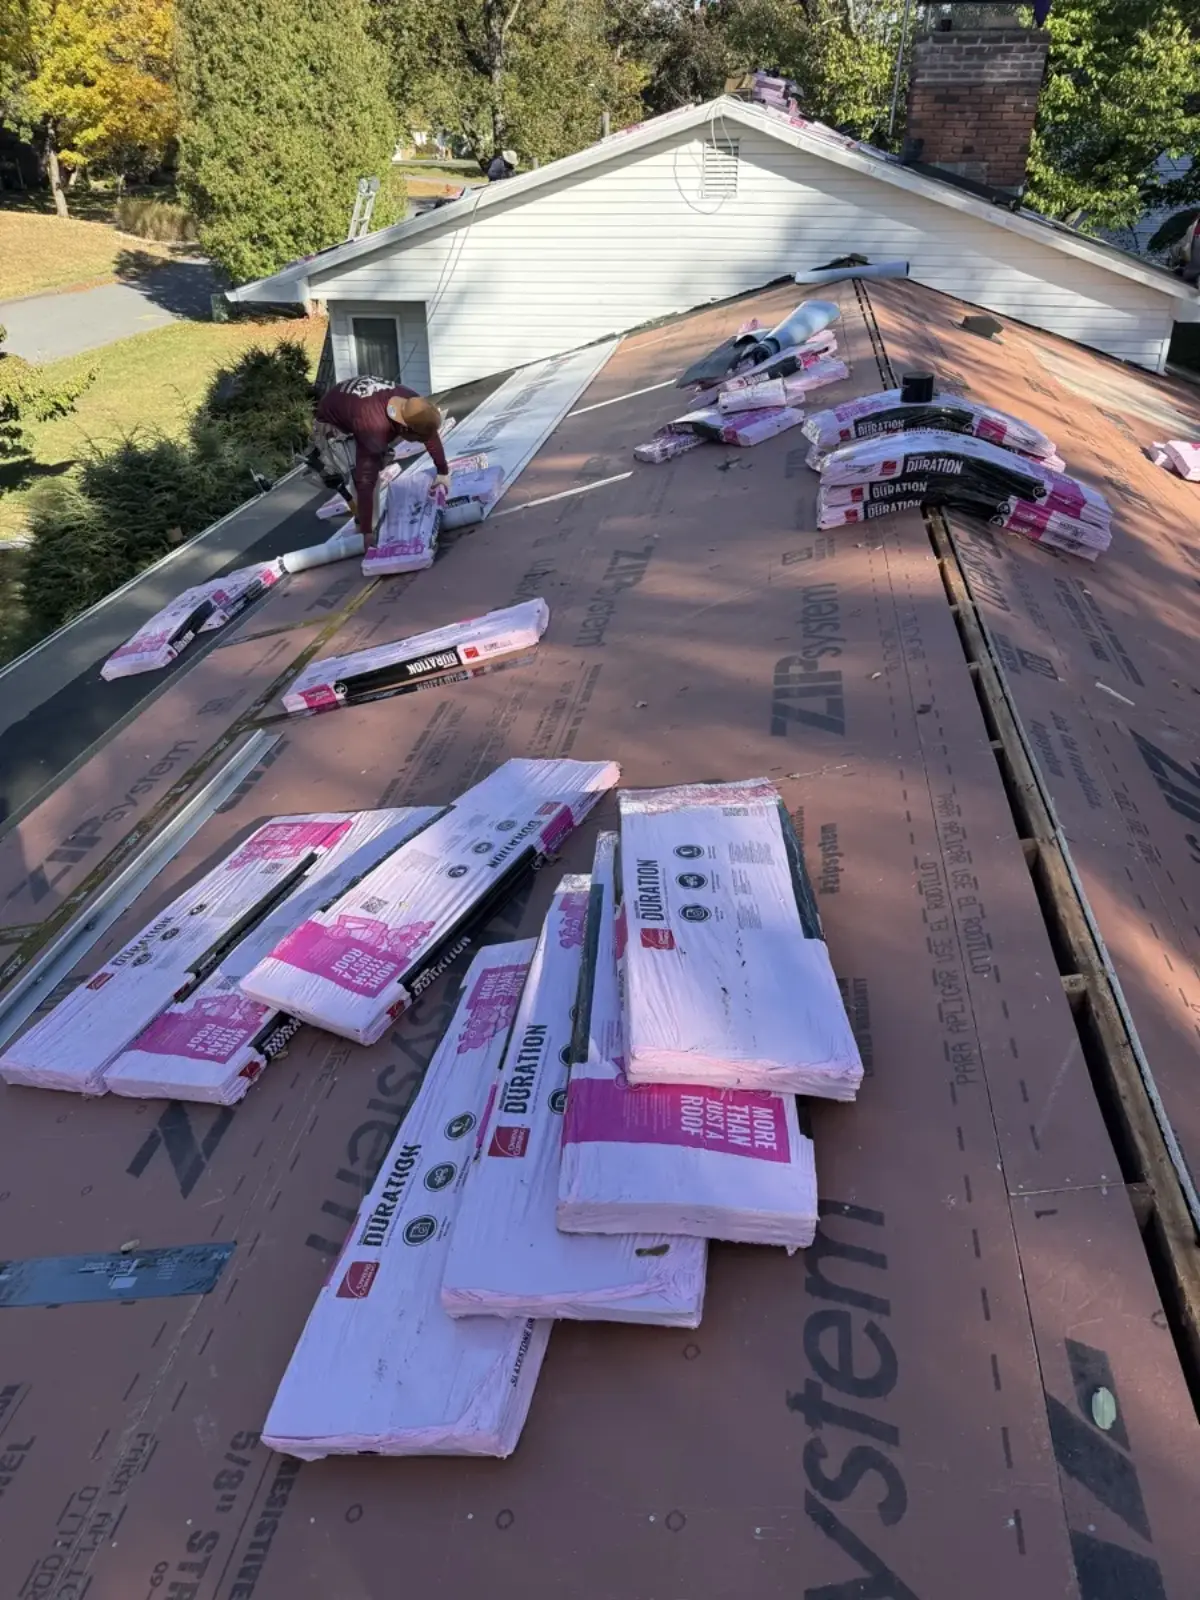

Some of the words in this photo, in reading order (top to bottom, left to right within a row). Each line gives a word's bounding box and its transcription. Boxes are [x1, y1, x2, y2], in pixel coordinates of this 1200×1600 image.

[857, 419, 905, 438] DURATION
[906, 457, 964, 475] DURATION
[872, 482, 928, 500] DURATION
[867, 499, 922, 518] DURATION
[406, 651, 458, 676] DURATION
[770, 582, 847, 737] ZIPsystem
[486, 819, 542, 869] DURATION
[636, 858, 665, 921] DURATION
[919, 861, 946, 911] RODILLO
[951, 868, 974, 891] USE
[957, 895, 978, 912] EL
[930, 915, 950, 933] EL
[112, 914, 174, 967] DURATION
[932, 938, 955, 964] USE
[961, 916, 993, 974] RODILLO
[330, 947, 364, 977] ROOF
[341, 971, 353, 980] A
[349, 953, 373, 973] JUST
[363, 961, 398, 991] MORE
[413, 936, 472, 996] DURATION
[477, 972, 500, 1000] MORE
[937, 969, 971, 1034] APLICAR
[186, 1023, 217, 1049] ROOF
[195, 1045, 205, 1053] A
[203, 1026, 226, 1045] JUST
[204, 1027, 235, 1056] THAN
[217, 1028, 249, 1056] MORE
[264, 1018, 302, 1057] DURA
[503, 1023, 549, 1115] DURATION
[951, 1041, 979, 1086] PARA
[679, 1093, 704, 1138] ROOF
[704, 1096, 723, 1128] JUST
[726, 1103, 752, 1148] THAN
[706, 1128, 726, 1141] A
[750, 1104, 778, 1151] MORE
[362, 1143, 423, 1247] DURATION
[213, 1429, 262, 1514] 5/8"
[229, 1458, 303, 1600] RESISTIVE
